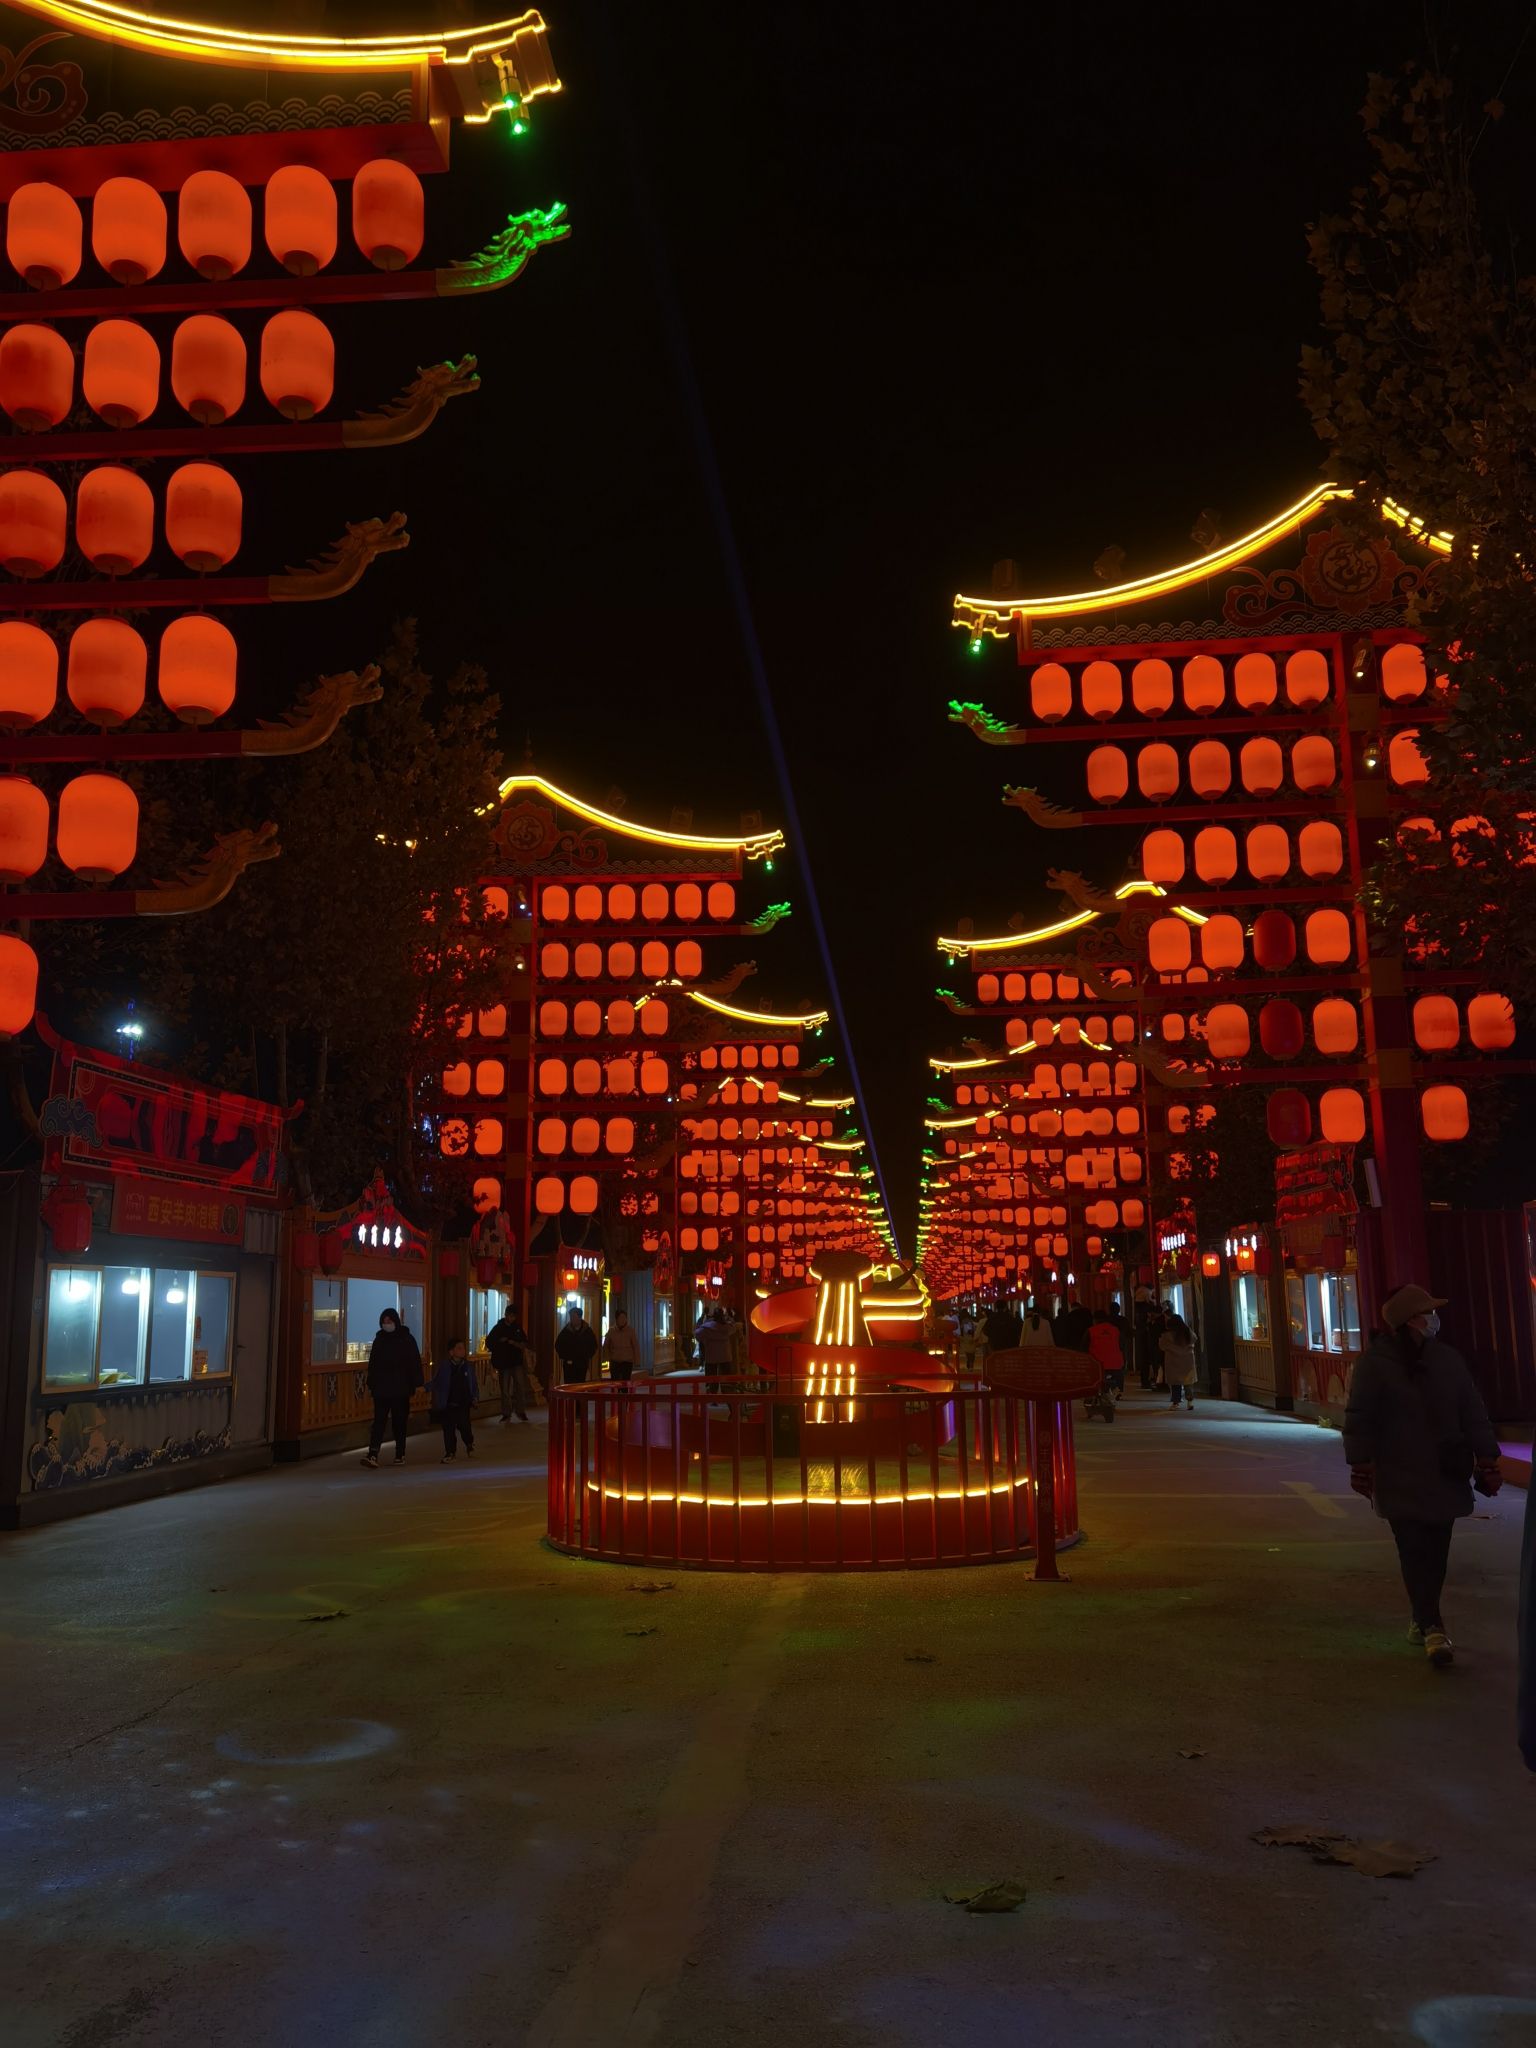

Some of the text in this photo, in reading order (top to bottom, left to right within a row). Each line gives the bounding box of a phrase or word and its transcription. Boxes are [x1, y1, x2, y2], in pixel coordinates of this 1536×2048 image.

[148, 1195, 220, 1230] 西安羊肉泡馍
